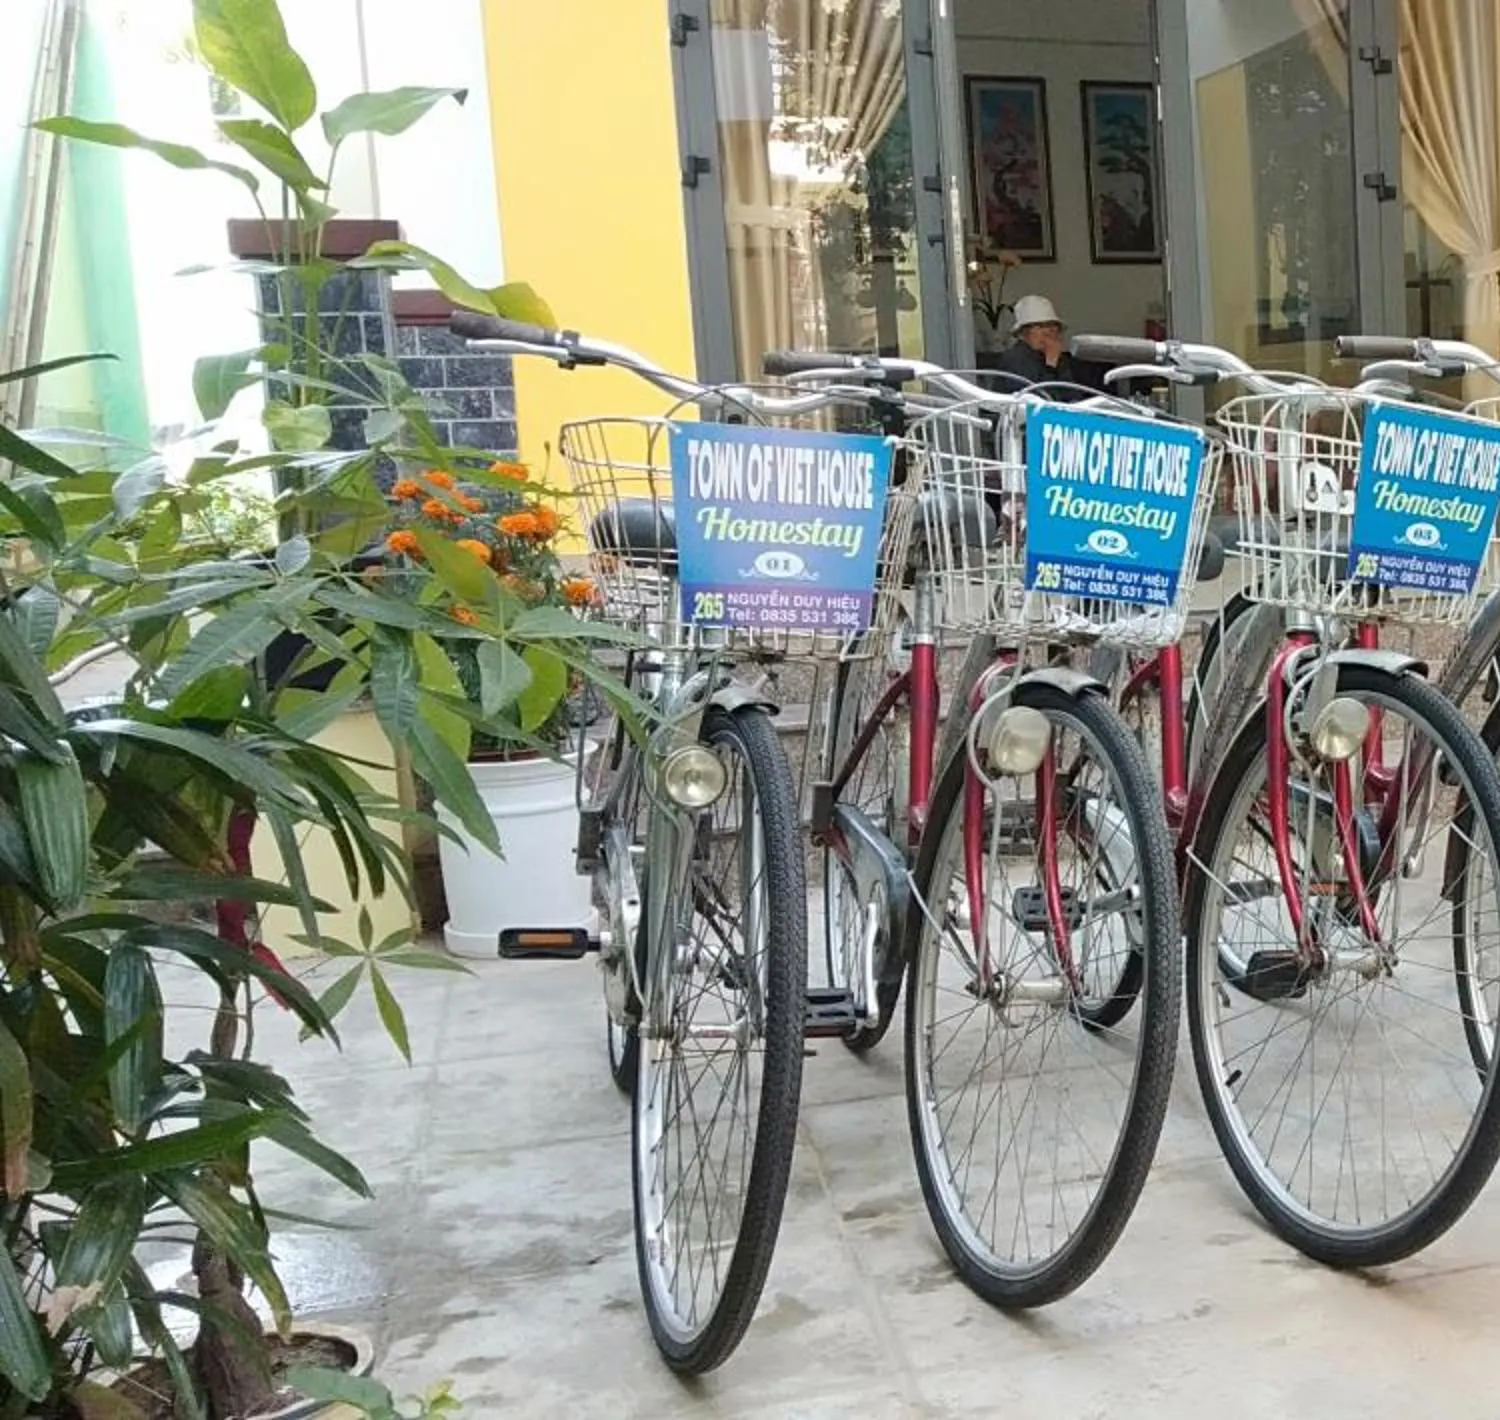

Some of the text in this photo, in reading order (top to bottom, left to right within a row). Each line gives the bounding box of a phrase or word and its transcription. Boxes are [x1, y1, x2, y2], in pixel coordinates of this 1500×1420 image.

[1041, 424, 1191, 497] TOWN OF VIET HOUSE
[1372, 421, 1418, 478] TOWN
[1414, 429, 1438, 481] OF
[1434, 431, 1465, 486] VIET
[688, 440, 875, 509] TOWN OF VIET HOUSE
[1045, 485, 1177, 540] Homestay
[1373, 480, 1487, 533] Homestay
[696, 506, 864, 558] Homestay
[1036, 561, 1061, 589] 265
[1116, 569, 1139, 584] DUY
[1425, 562, 1447, 574] DUY
[793, 595, 824, 608] DUY
[1064, 578, 1086, 591] Tel:
[1088, 583, 1118, 596] 0835
[1121, 586, 1142, 598] 531
[694, 592, 725, 619] 265
[729, 609, 755, 621] Tel:
[760, 609, 797, 623] 0835
[801, 610, 827, 623] 531
